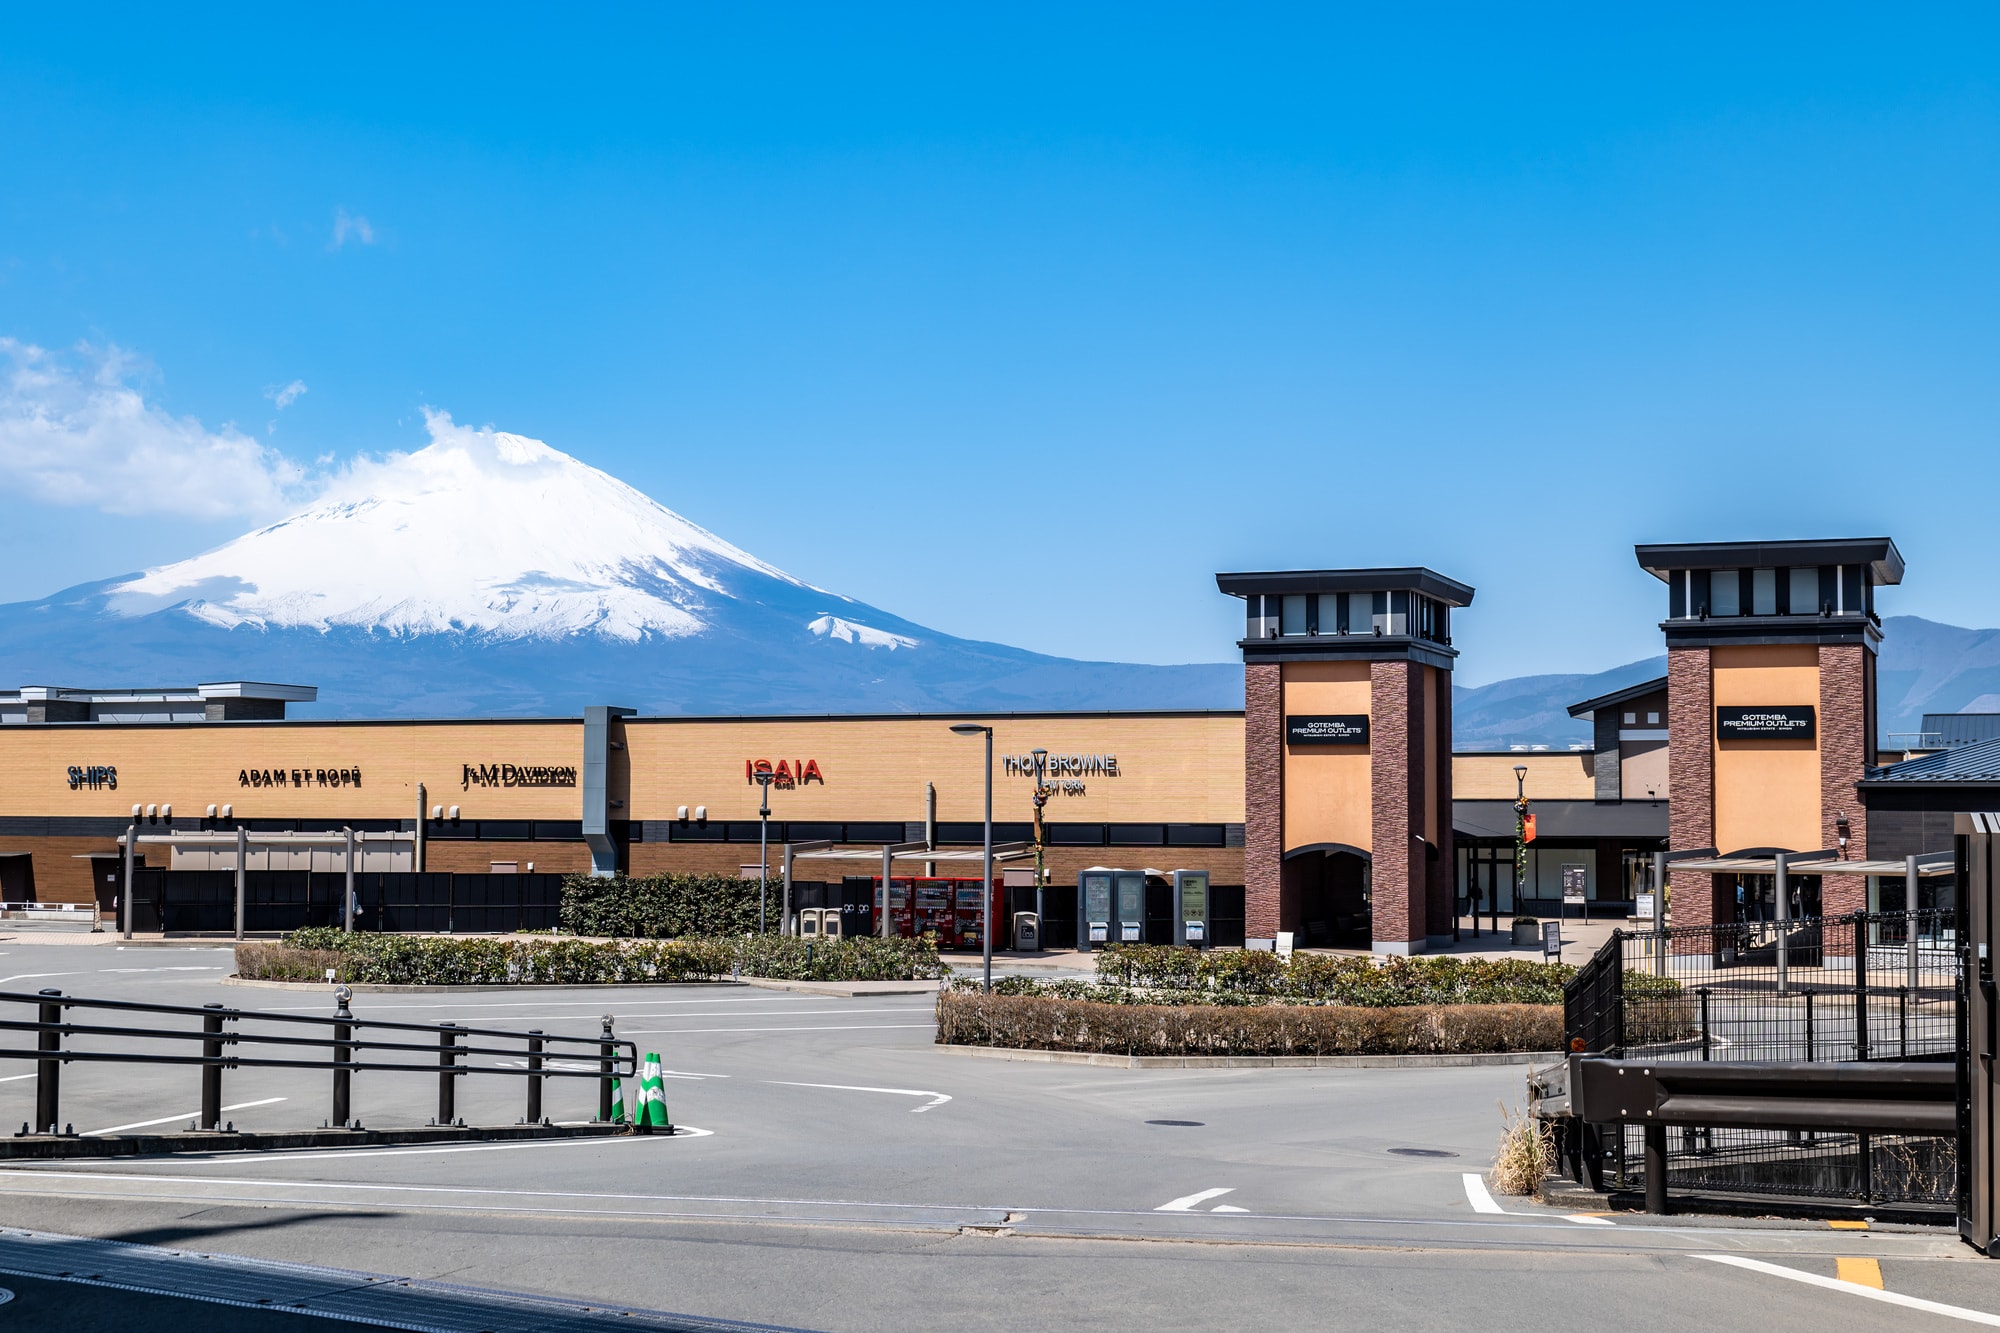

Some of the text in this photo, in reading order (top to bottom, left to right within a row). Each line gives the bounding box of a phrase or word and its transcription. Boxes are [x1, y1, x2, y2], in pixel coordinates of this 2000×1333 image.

[67, 765, 116, 785] SHIPS
[239, 765, 360, 782] ADAM ET ROPÉ
[461, 763, 498, 785] J&M
[745, 759, 822, 779] ISAIA
[1060, 779, 1084, 790] YORK
